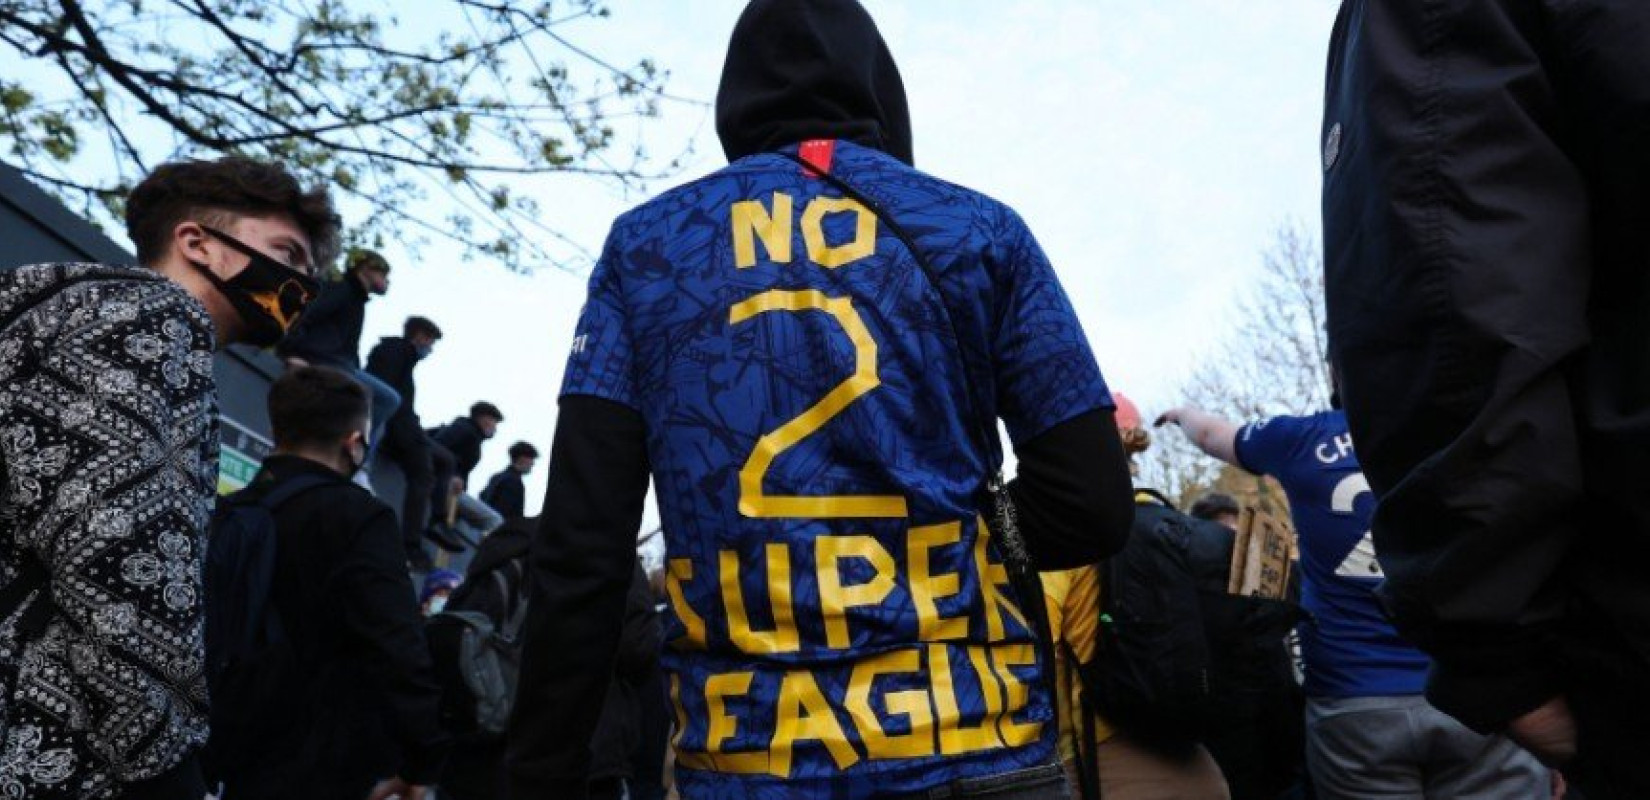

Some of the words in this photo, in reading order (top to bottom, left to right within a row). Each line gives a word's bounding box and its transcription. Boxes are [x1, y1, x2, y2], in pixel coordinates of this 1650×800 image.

[731, 191, 878, 268] NO
[729, 289, 908, 518] 2
[664, 513, 1036, 654] SUPER
[670, 642, 1044, 778] LEAGUE
